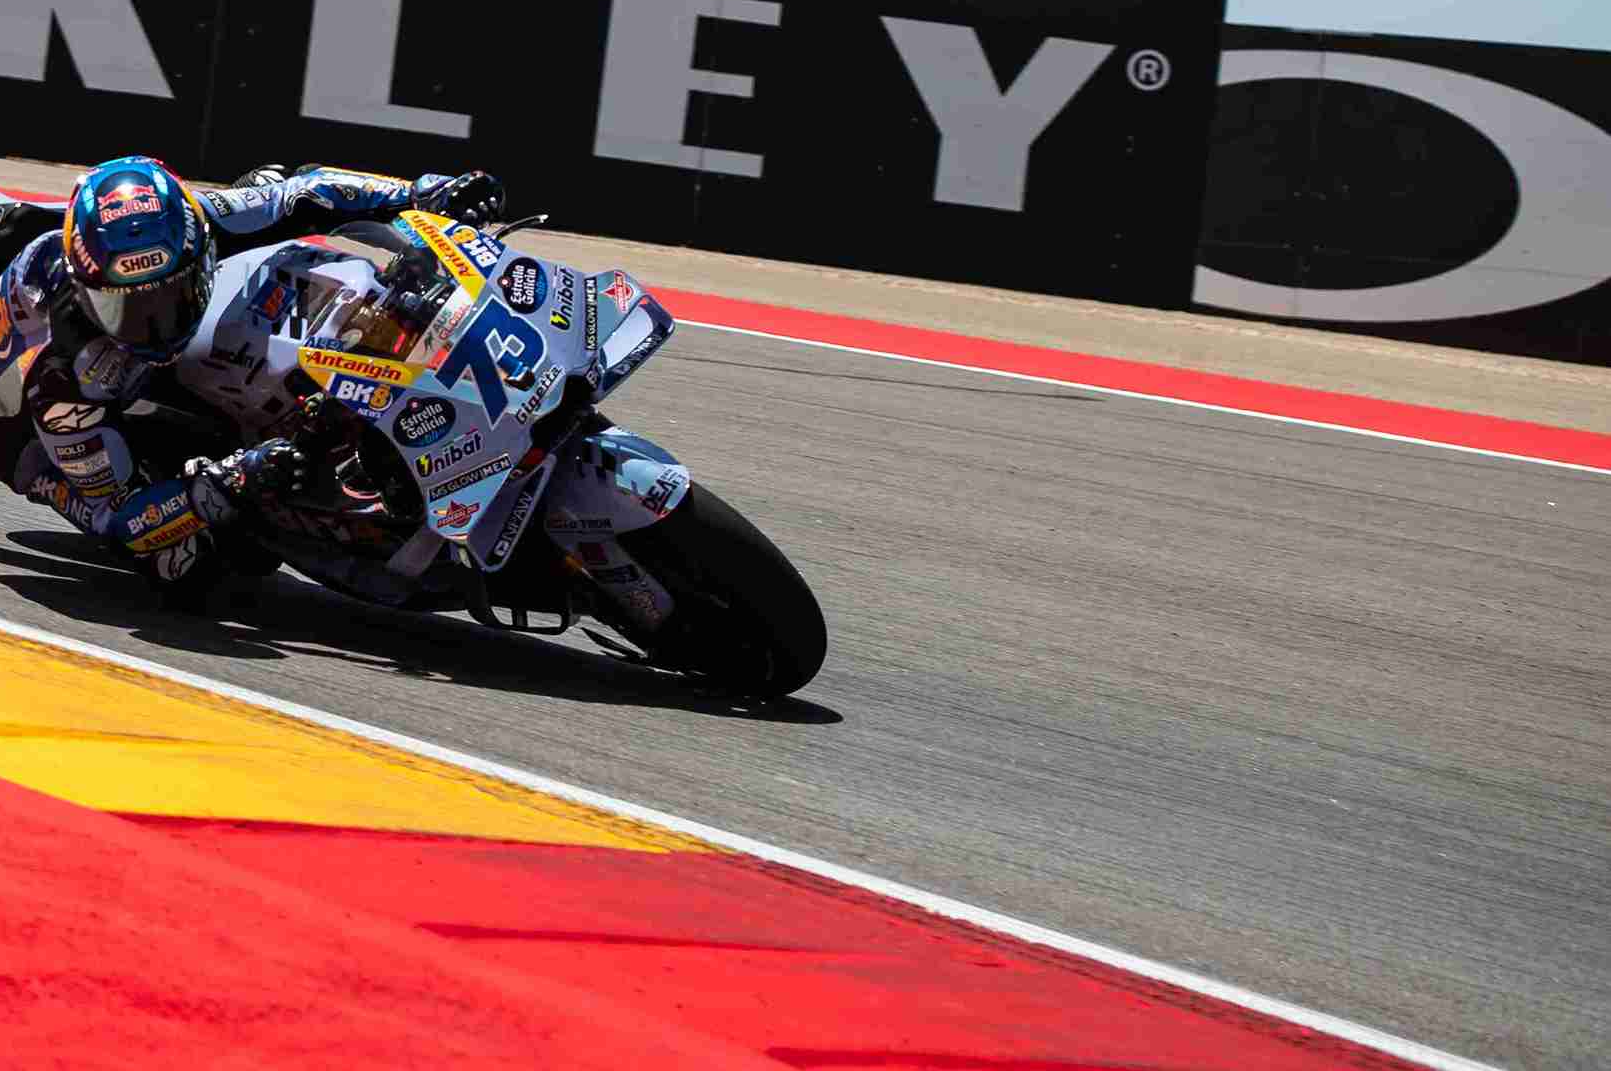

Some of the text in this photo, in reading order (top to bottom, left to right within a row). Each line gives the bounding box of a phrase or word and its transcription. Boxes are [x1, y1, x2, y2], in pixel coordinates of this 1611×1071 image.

[101, 198, 162, 225] Red Bull
[411, 212, 473, 277] Antangin
[121, 252, 164, 273] SHOEI
[510, 265, 525, 304] Estrella
[522, 268, 537, 305] Galicia
[550, 267, 574, 330] Unibat
[307, 351, 403, 382] Antangin
[338, 380, 393, 411] BK8
[400, 402, 443, 430] Estrella
[406, 415, 447, 440] Galicia
[415, 433, 484, 477] Unibat
